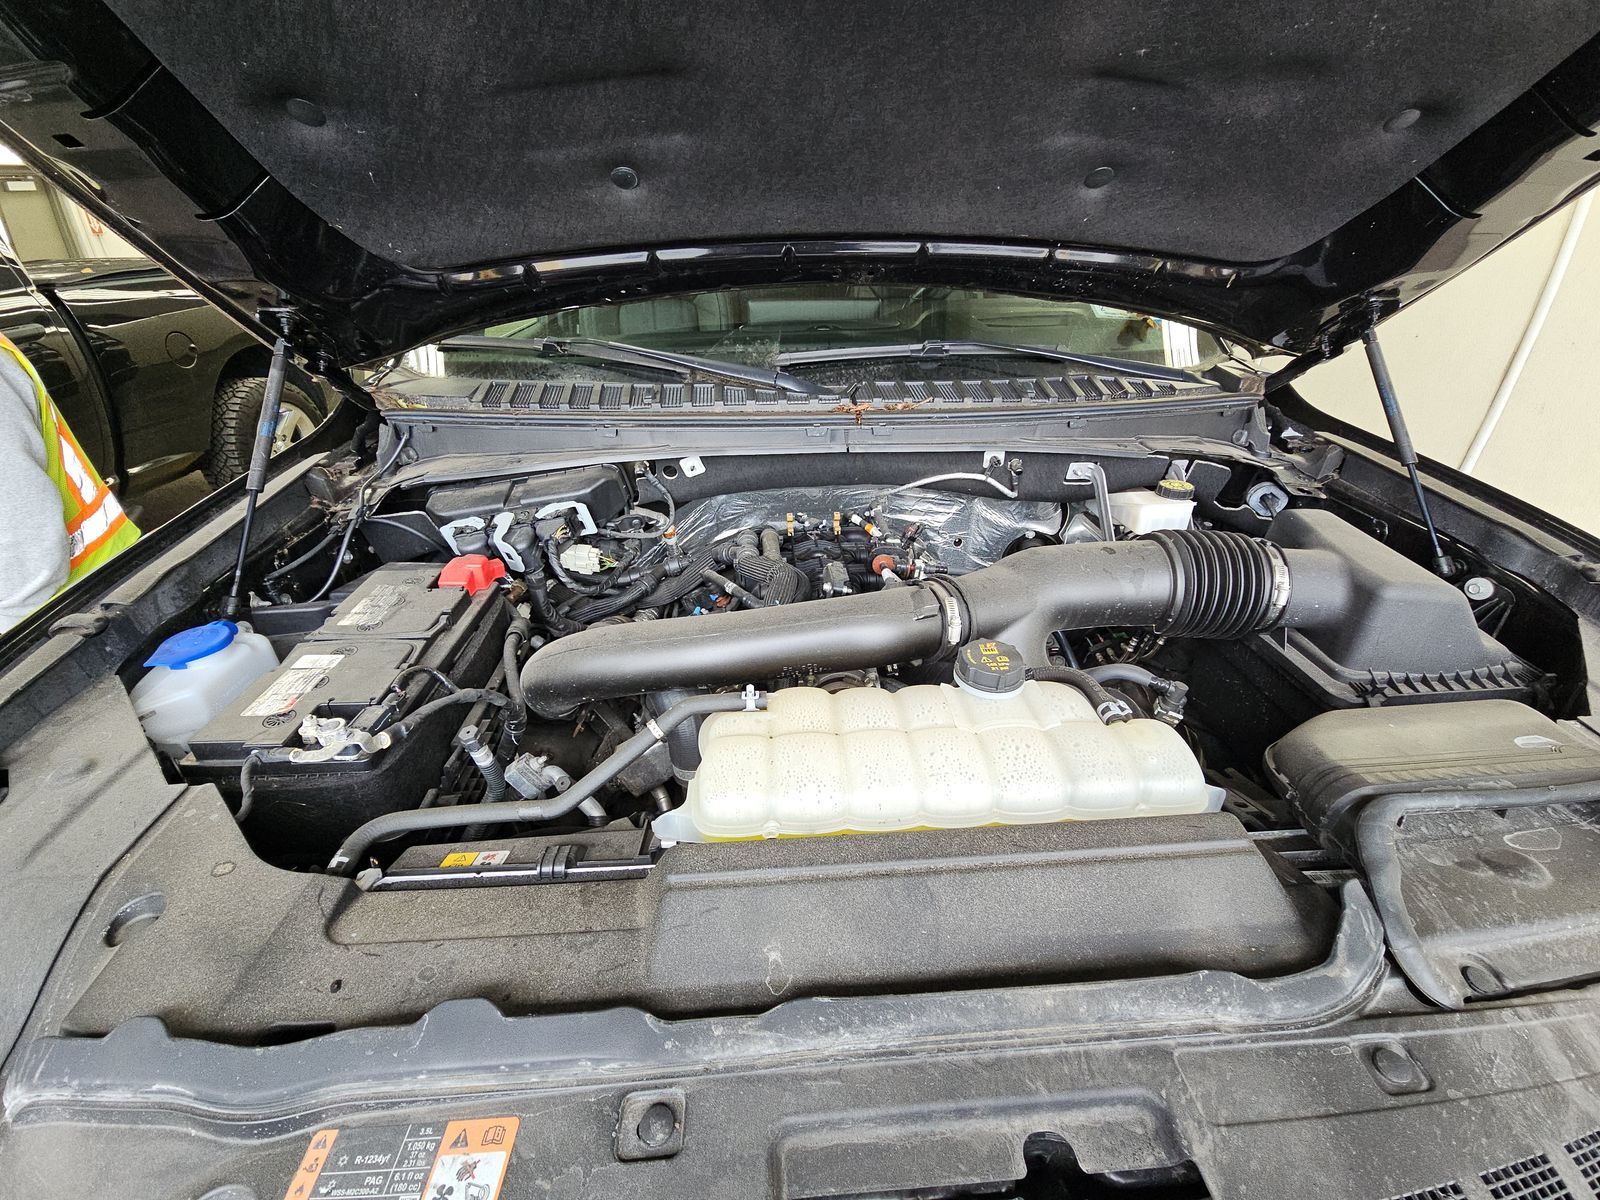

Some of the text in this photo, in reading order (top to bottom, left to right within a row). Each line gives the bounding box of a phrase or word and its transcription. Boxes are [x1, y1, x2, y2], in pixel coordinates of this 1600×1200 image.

[408, 1141, 436, 1152] 1.050 kg
[354, 1153, 392, 1165] R-1234yf
[410, 1151, 418, 1159] 37
[364, 1176, 383, 1186] PAG
[394, 1172, 406, 1181] 6.1
[390, 1182, 421, 1194] (180 cc)
